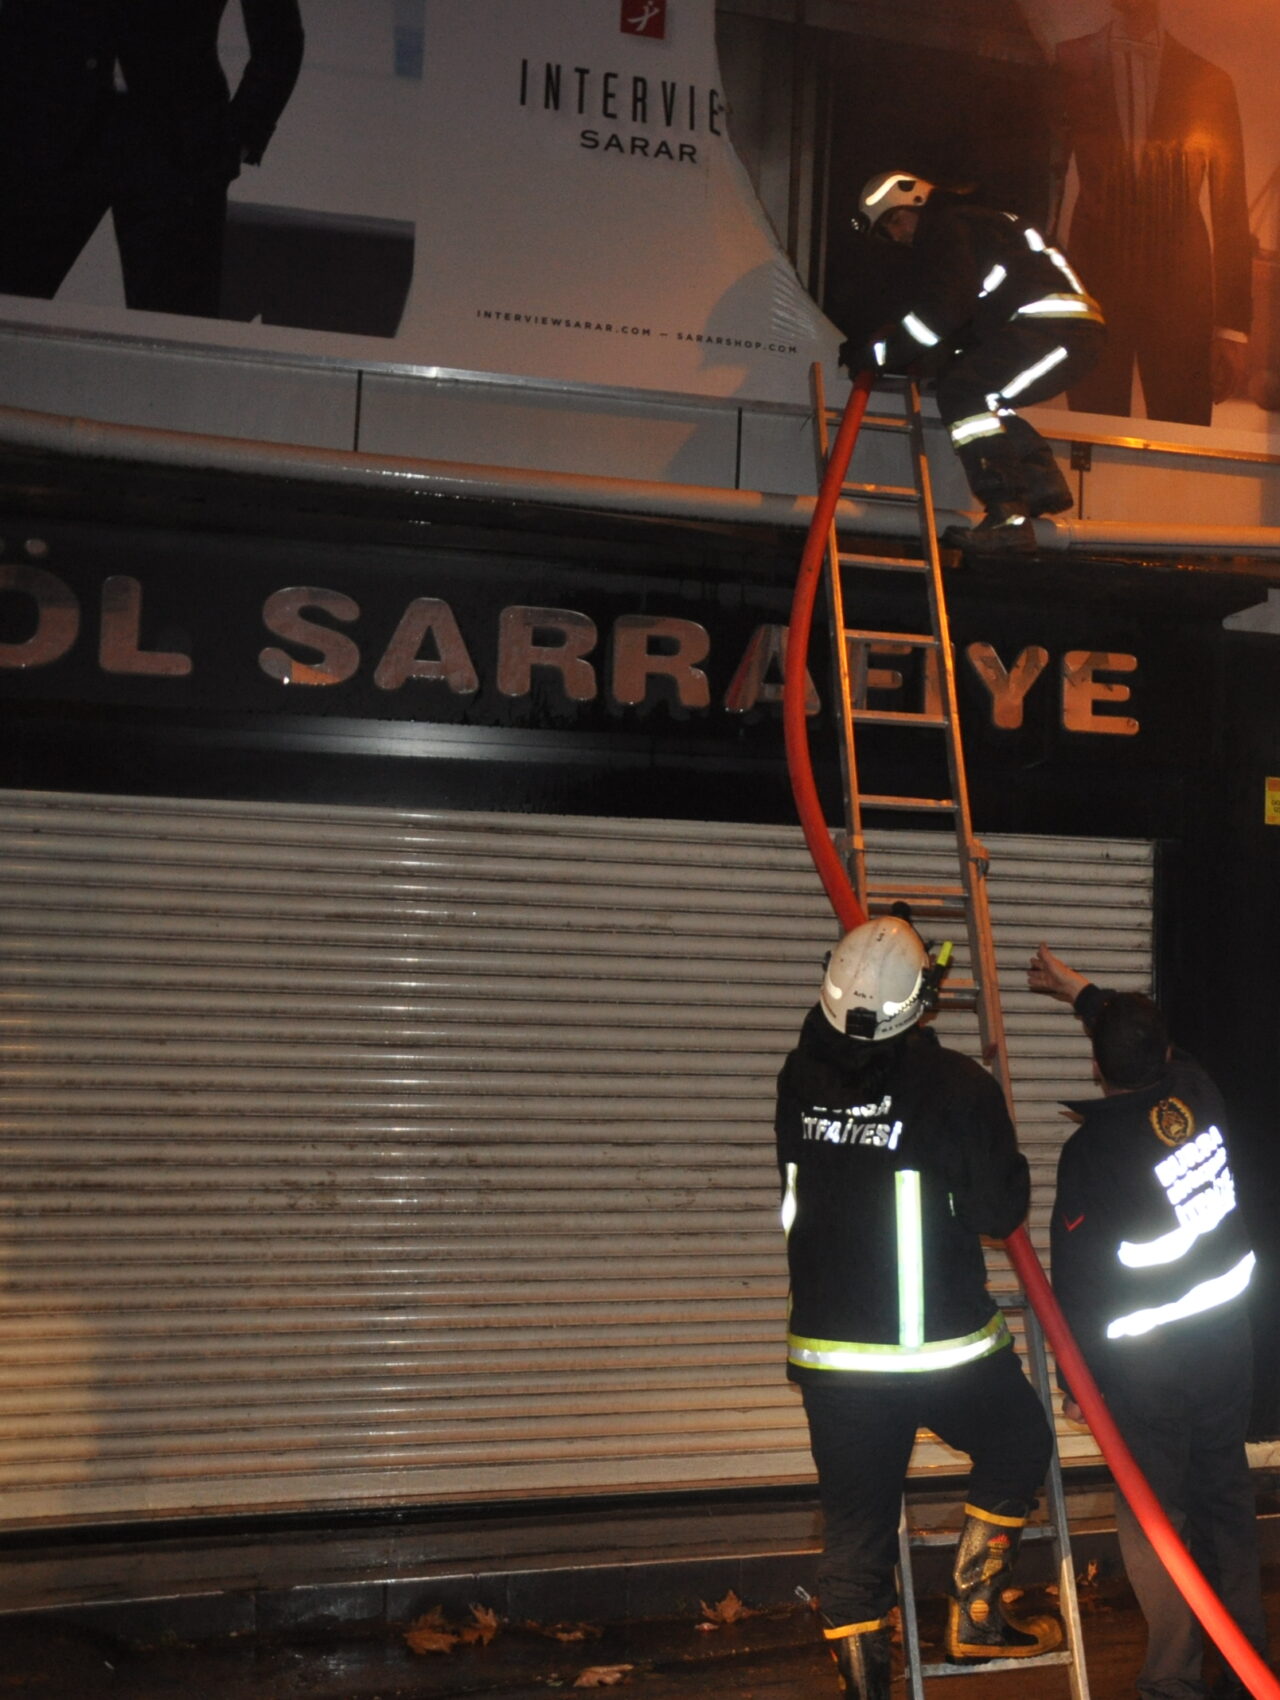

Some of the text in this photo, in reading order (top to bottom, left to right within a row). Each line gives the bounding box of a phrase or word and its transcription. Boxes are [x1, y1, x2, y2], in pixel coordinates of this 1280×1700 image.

[580, 129, 698, 164] SARAR
[476, 309, 798, 354] INTERVIEWSARAR.COM SARARSHOP.COM
